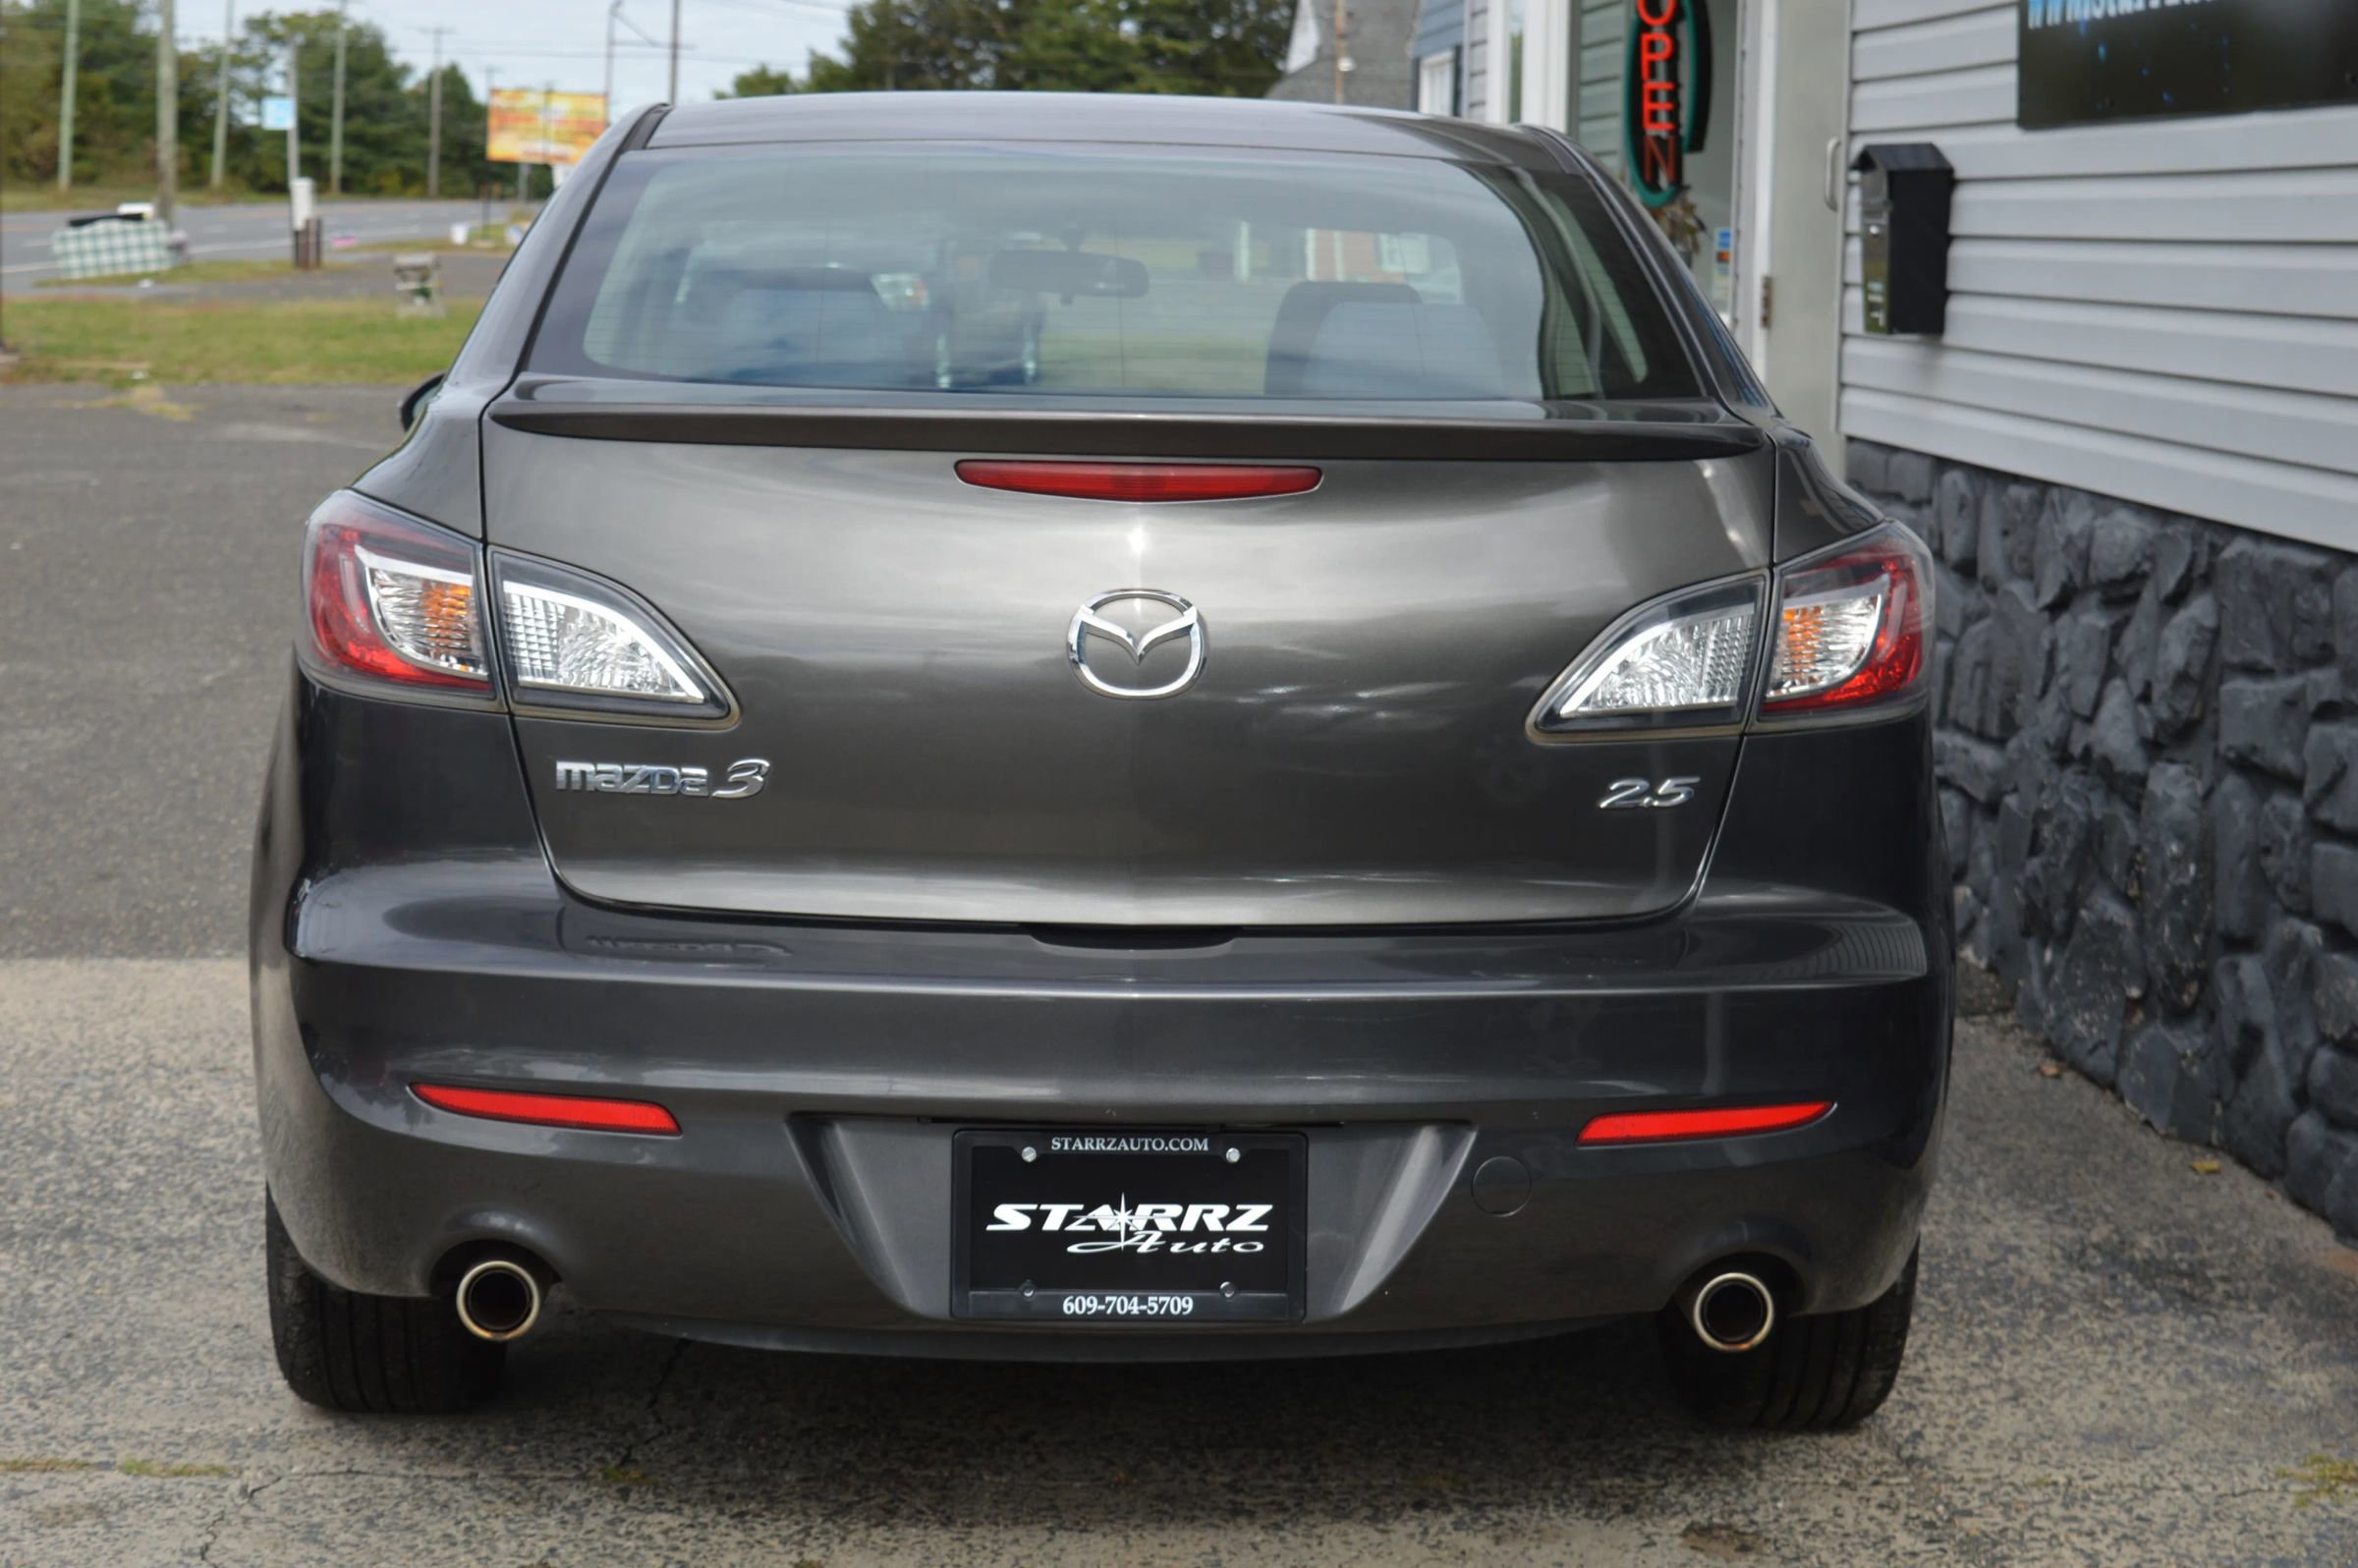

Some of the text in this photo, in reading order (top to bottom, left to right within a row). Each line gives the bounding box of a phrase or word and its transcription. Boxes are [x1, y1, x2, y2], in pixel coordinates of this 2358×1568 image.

[1637, 0, 1677, 184] OPEN
[1600, 776, 1701, 808] 2.5
[1051, 1137, 1209, 1151] STARRZAUTO.COM
[985, 1204, 1273, 1231] STARRZ
[1066, 1230, 1264, 1254] Auto
[1062, 1295, 1194, 1316] 609-704-5709
